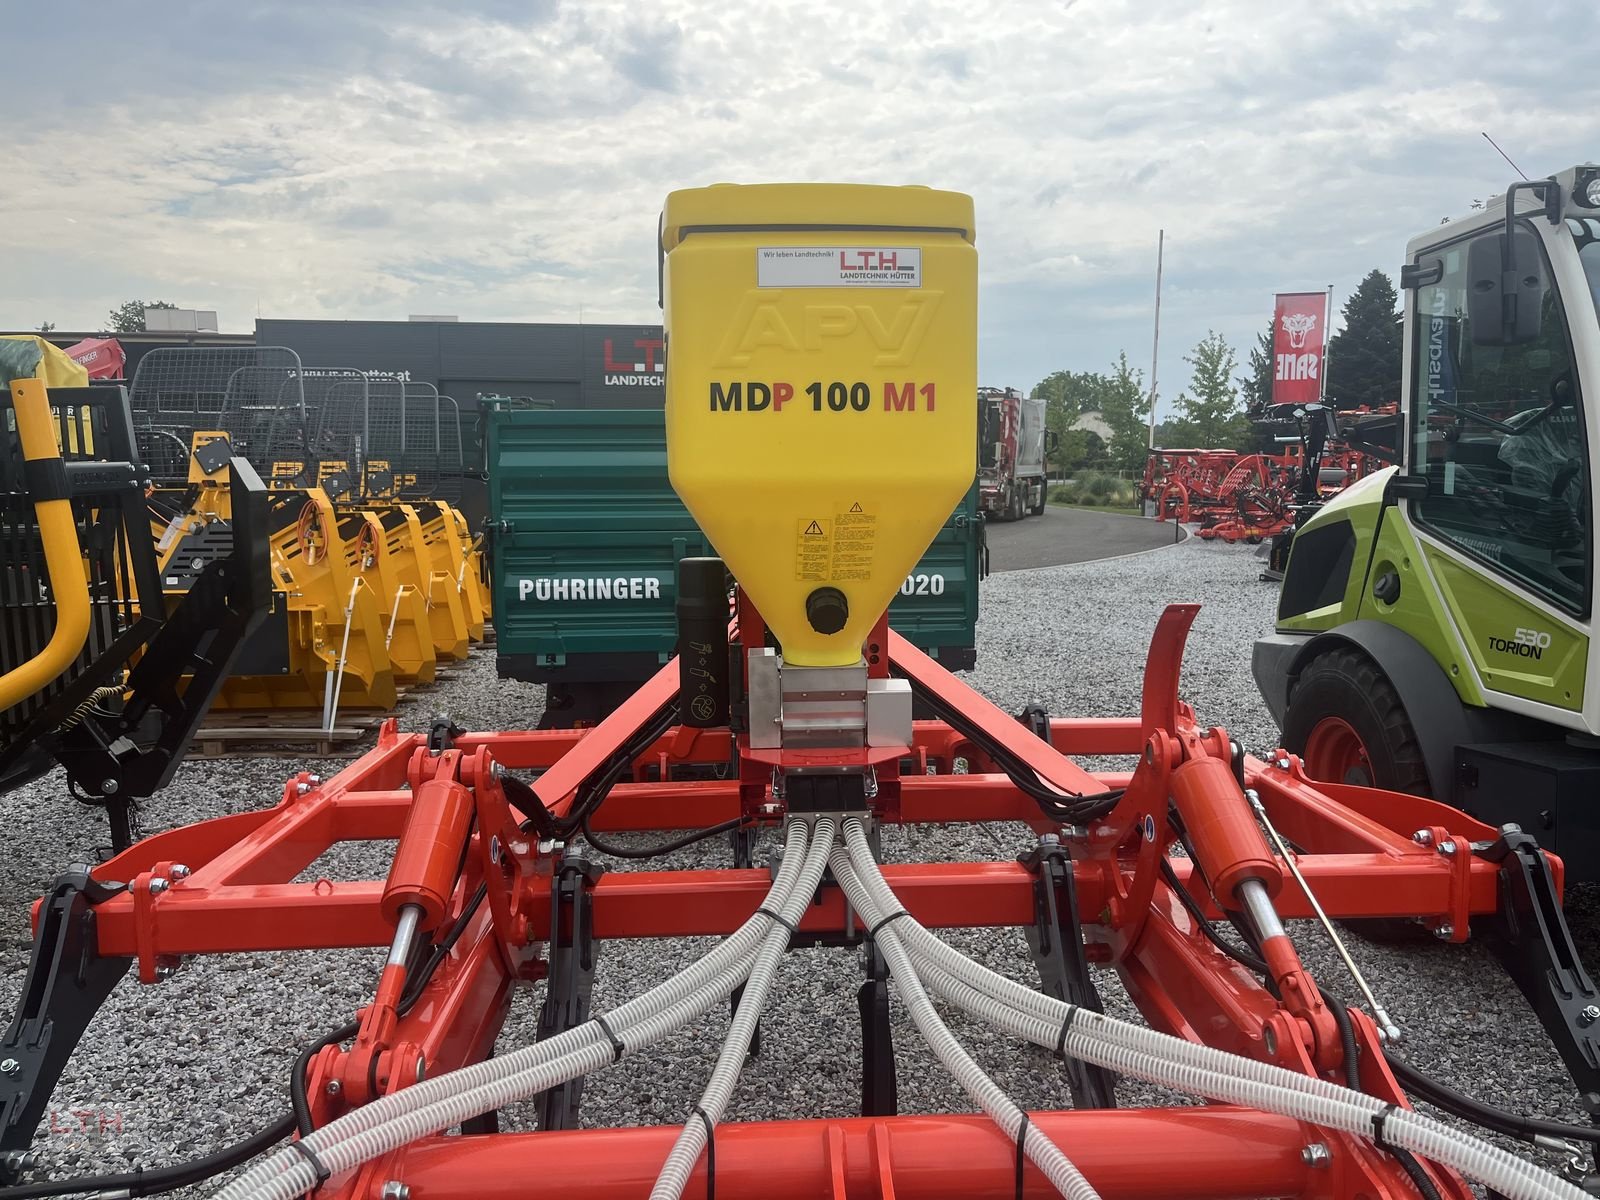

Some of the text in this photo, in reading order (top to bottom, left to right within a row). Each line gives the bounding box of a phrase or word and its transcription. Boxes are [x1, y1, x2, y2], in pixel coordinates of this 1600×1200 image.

[776, 250, 794, 258] leben
[890, 271, 915, 280] HÜTTER
[604, 375, 665, 386] LANDTECH
[709, 381, 936, 412] MDP 100 M1
[519, 577, 660, 601] PÜHRINGER
[898, 573, 945, 596] 020
[1488, 636, 1543, 660] TORION
[1514, 627, 1551, 649] 530
